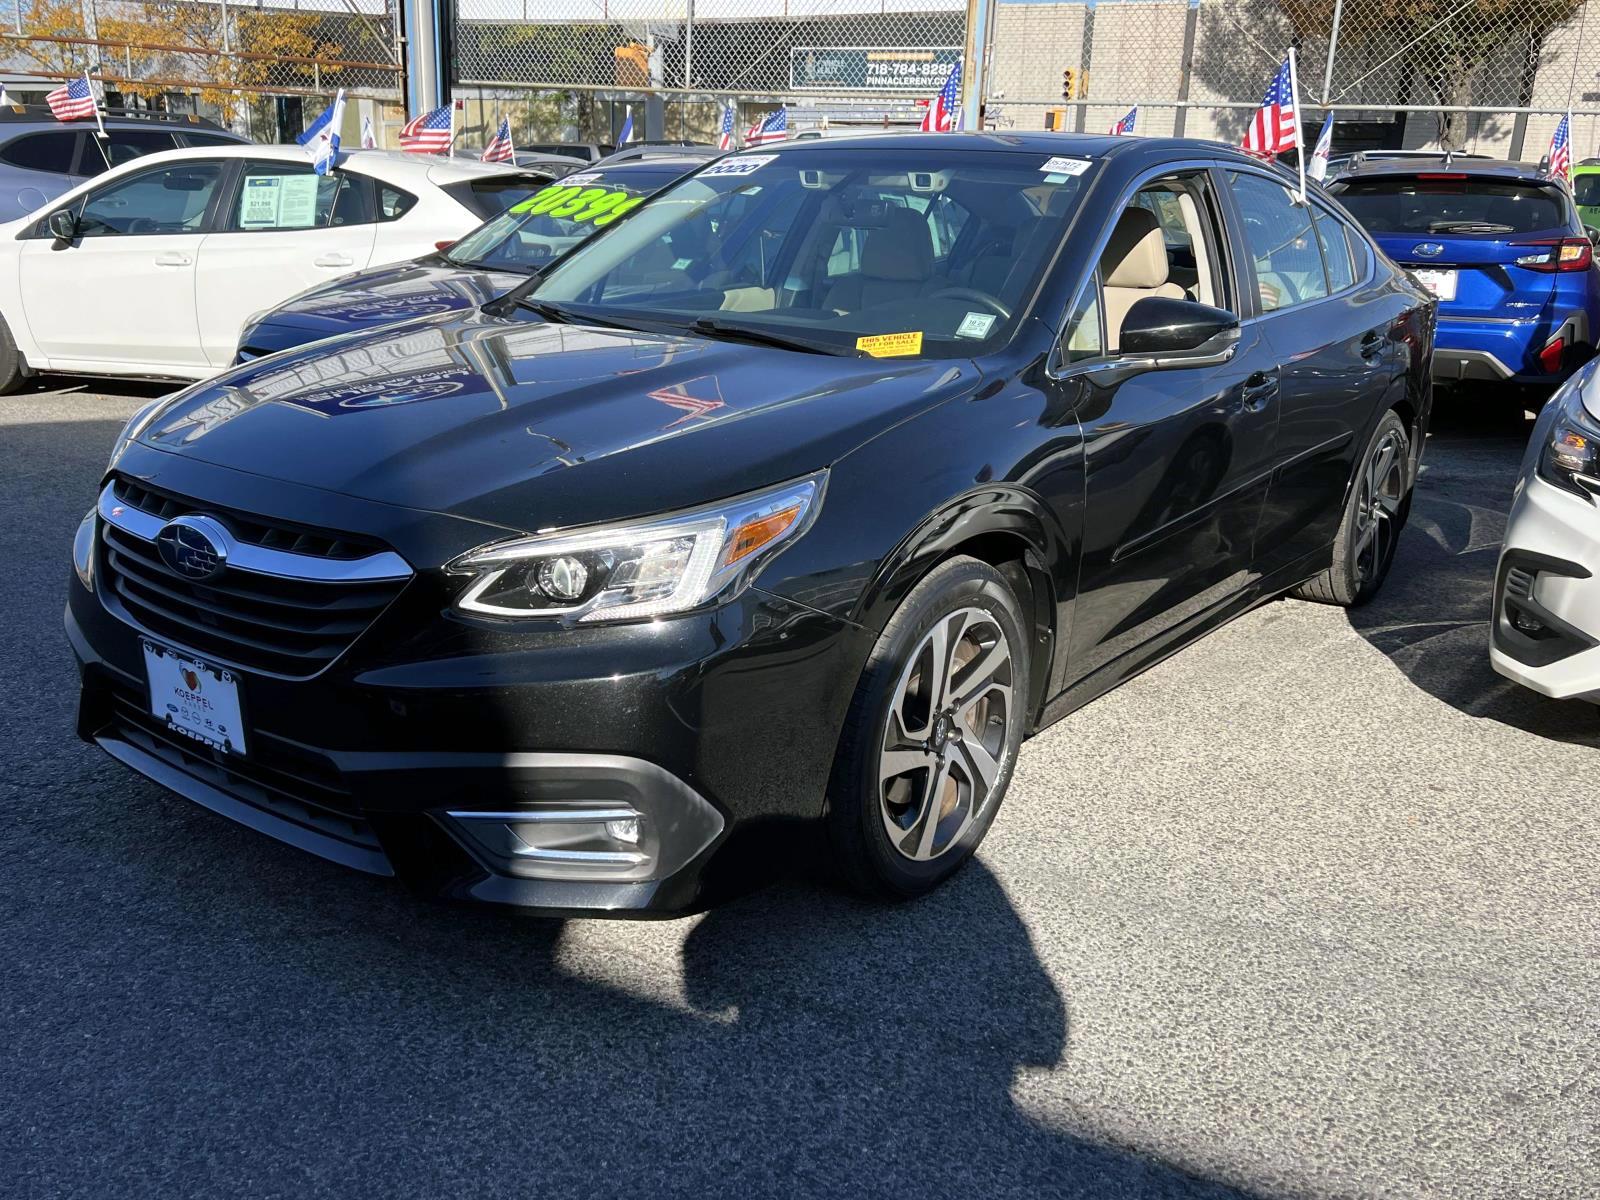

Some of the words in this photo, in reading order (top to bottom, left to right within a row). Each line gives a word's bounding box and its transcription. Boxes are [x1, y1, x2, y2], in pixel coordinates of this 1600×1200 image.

[868, 63, 955, 75] 718-784-8282
[867, 77, 948, 85] PINNACLERENY.CO
[702, 164, 760, 175] 2020
[175, 687, 214, 711] KOEPPEL
[168, 723, 228, 753] KOEPPEL
